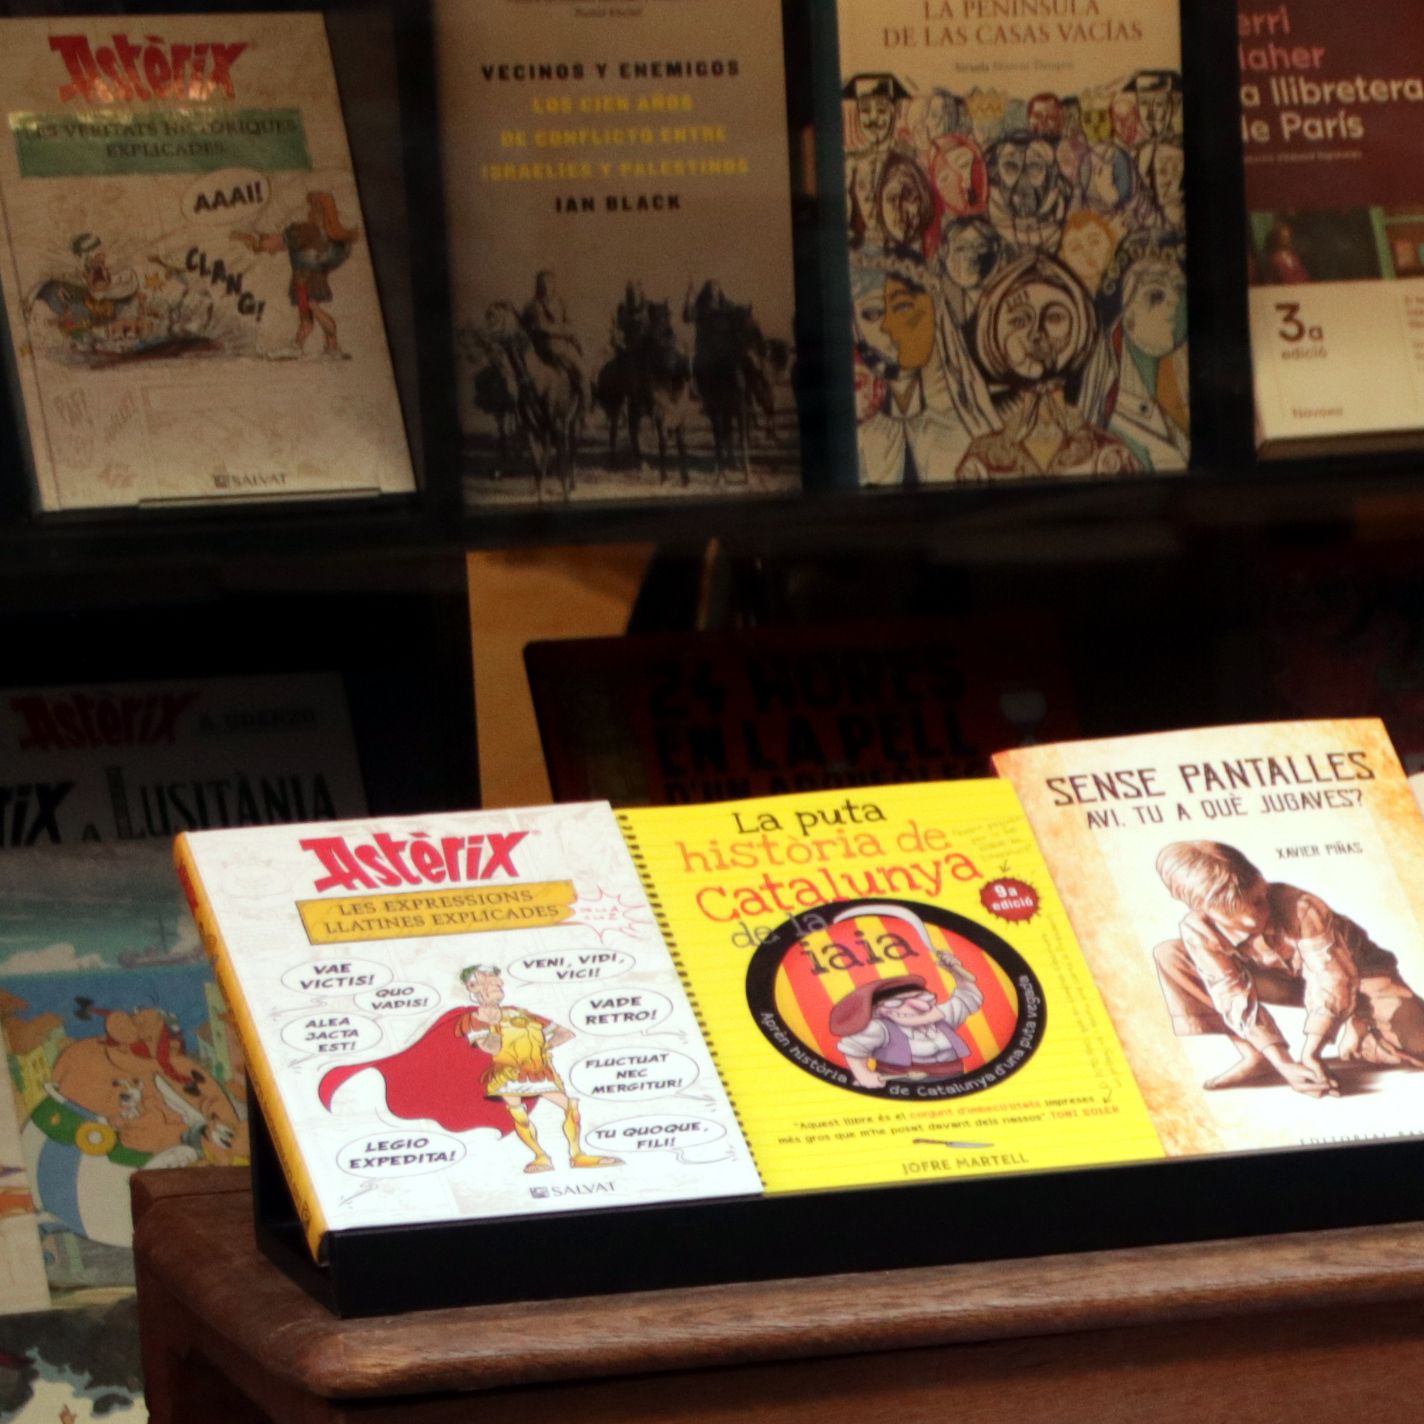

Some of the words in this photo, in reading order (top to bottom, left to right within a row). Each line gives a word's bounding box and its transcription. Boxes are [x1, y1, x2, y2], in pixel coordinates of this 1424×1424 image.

[884, 28, 917, 48] DE
[925, 27, 967, 47] LAS
[976, 24, 1051, 45] CASAS
[1058, 18, 1143, 42] VACÍAS
[482, 65, 584, 80] VECINOS
[597, 64, 607, 79] Y
[620, 61, 740, 79] ENEMIGOS
[1271, 76, 1424, 106] llibretera
[1281, 110, 1364, 141] París
[556, 197, 594, 213] IAN
[606, 196, 681, 212] BLACK
[1282, 346, 1327, 361] edició
[1046, 768, 1166, 807] SENSE
[1179, 752, 1376, 793] PANTALLES
[1138, 805, 1163, 823] TU
[1177, 804, 1191, 821] A
[1200, 793, 1248, 819] QUÈ
[1260, 788, 1363, 812] JUGAVES?
[734, 809, 773, 834] La
[800, 799, 888, 837] puta
[675, 828, 887, 874] història
[897, 819, 952, 853] de
[1275, 844, 1320, 860] XAVIER
[1327, 841, 1363, 856] PIÑAS
[300, 831, 530, 892] Astèrix
[697, 852, 985, 923] Catalunya
[338, 903, 377, 917] LES
[384, 890, 534, 912] EXPRESSIONS
[992, 897, 1035, 911] edició
[326, 917, 423, 935] LLATINES
[433, 904, 560, 926] EXPLICADES
[731, 923, 780, 950] de
[791, 911, 829, 936] la
[802, 926, 921, 976] iaia
[313, 963, 352, 976] VAE
[556, 968, 600, 981] VICI!
[300, 974, 375, 990] VICTIS!
[376, 987, 414, 998] QUO
[372, 996, 428, 1011] VADIS!
[590, 996, 642, 1010] VADE
[305, 1017, 351, 1029] ALEA
[585, 1009, 658, 1026] RETRO!
[306, 1029, 359, 1042] JACTA
[318, 1041, 357, 1053] EST!
[586, 1053, 670, 1070] FLUCTUAT
[616, 1068, 648, 1080] NEC
[591, 1077, 684, 1095] MERGITUR!
[596, 1129, 617, 1141] TU
[637, 1137, 676, 1149] FILI!
[366, 1137, 430, 1153] LEGIO
[350, 1150, 456, 1170] EXPEDITA!
[902, 1160, 950, 1175] JOFRE
[956, 1153, 1030, 1172] MARTELL
[552, 1181, 617, 1198] SALVAT
